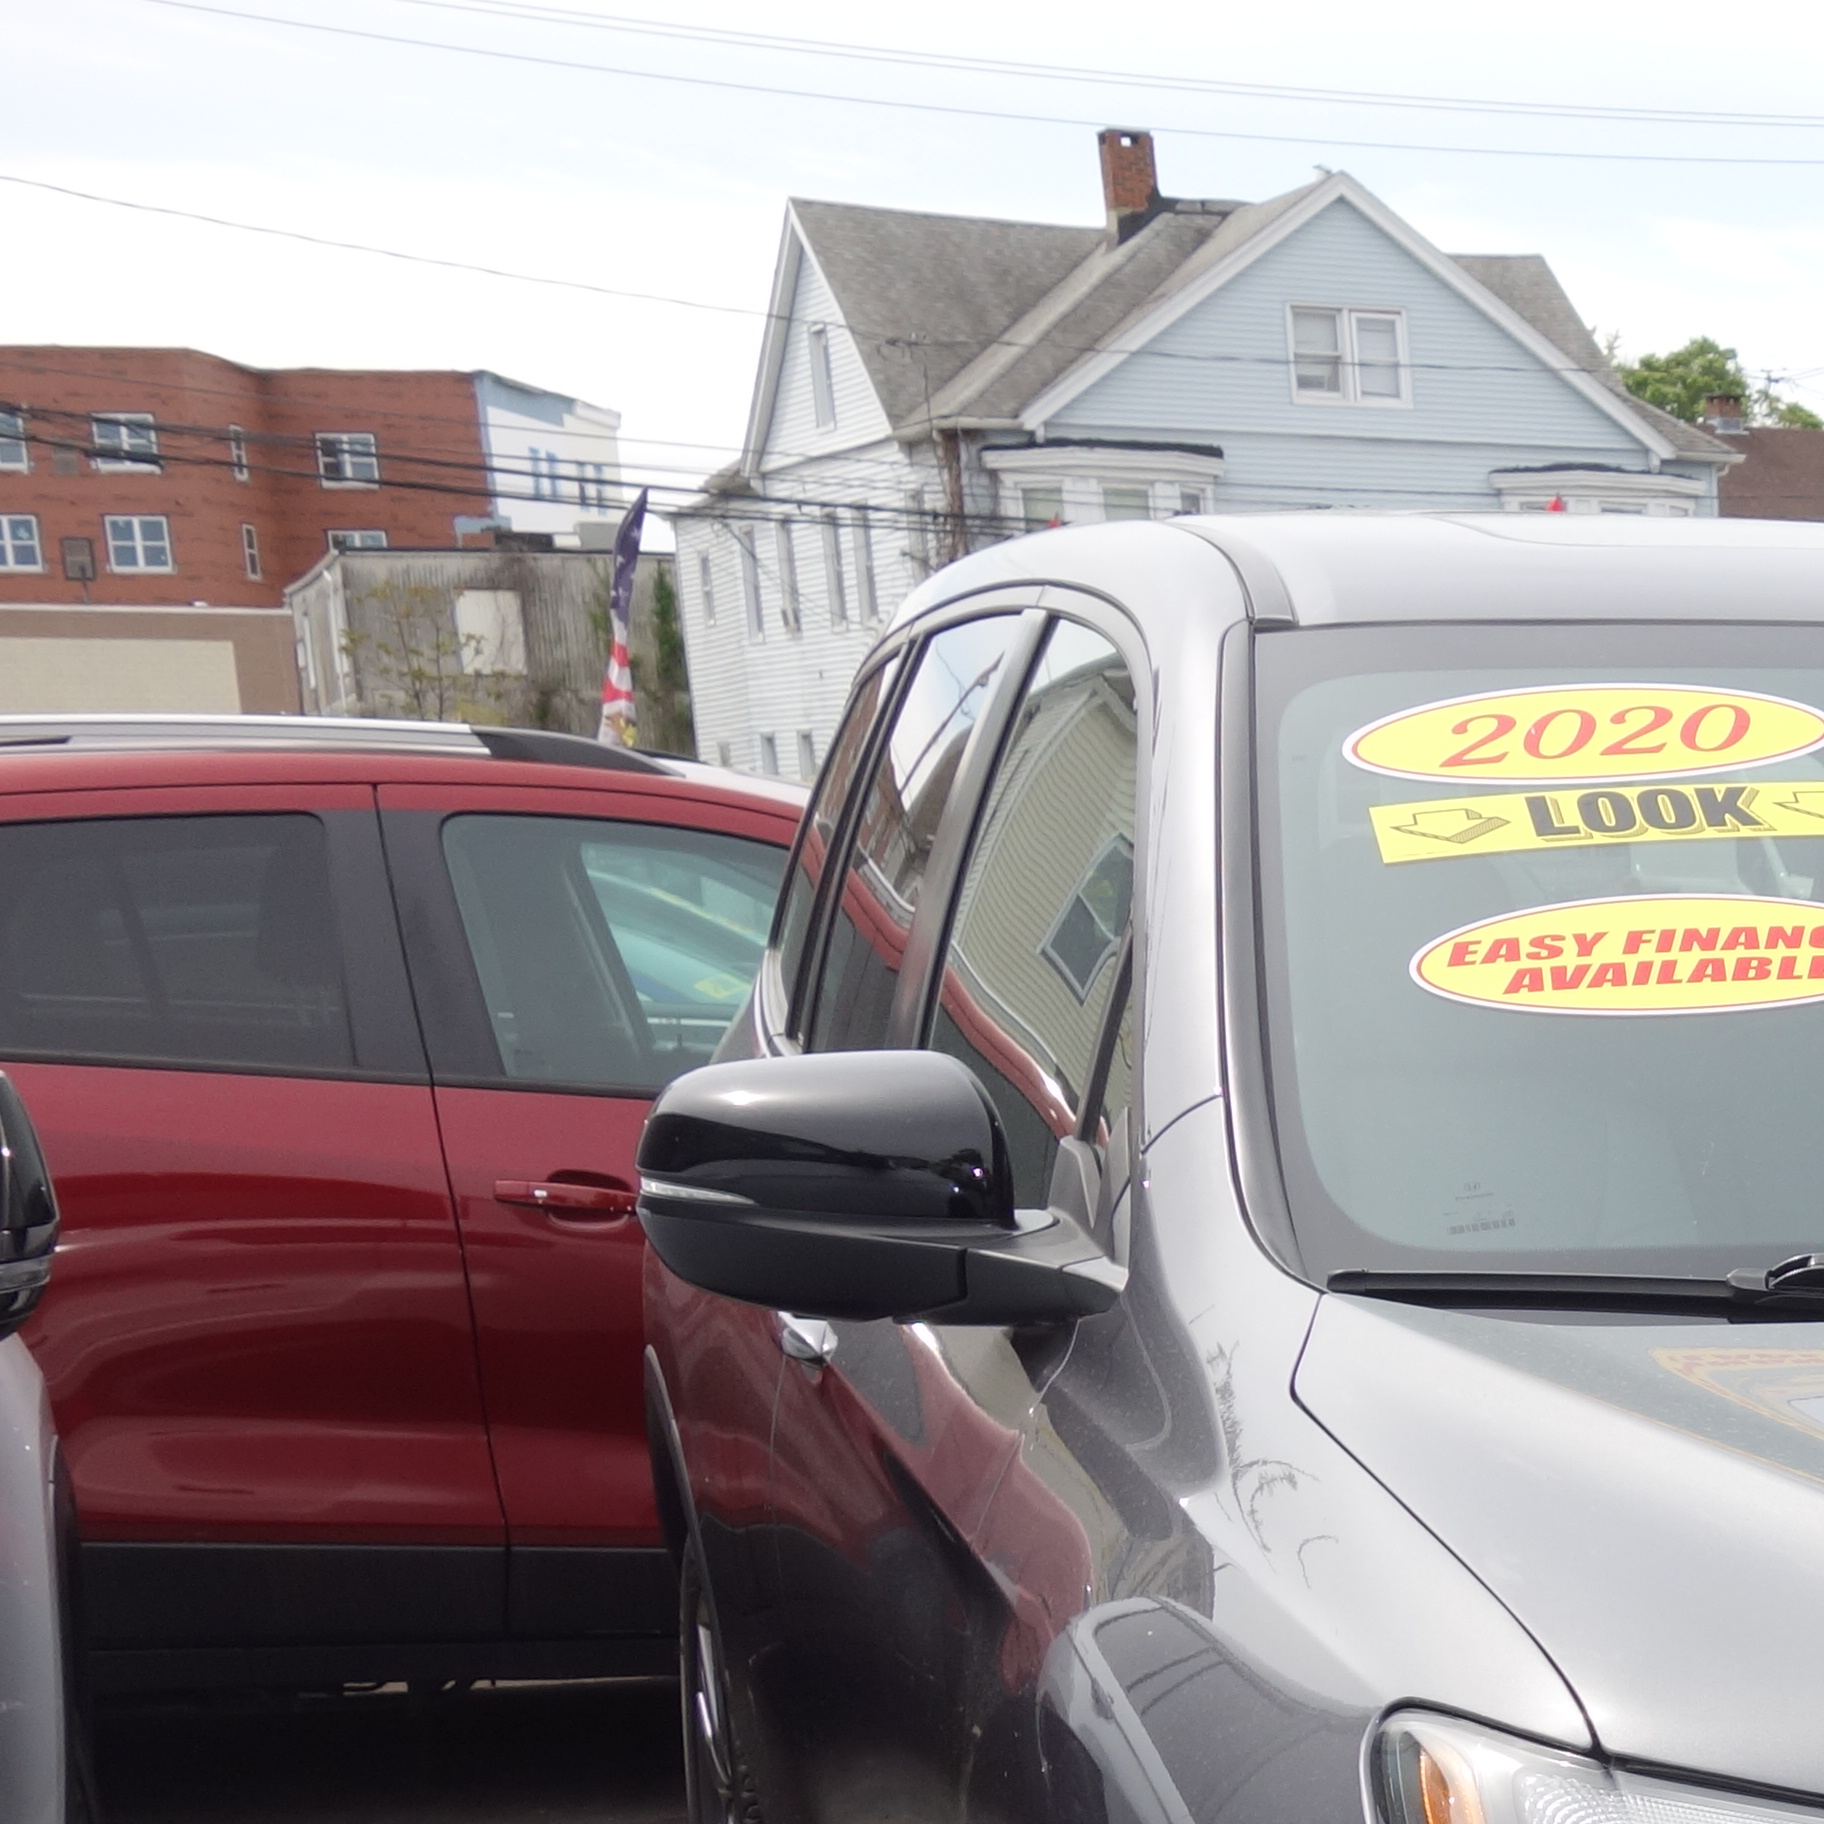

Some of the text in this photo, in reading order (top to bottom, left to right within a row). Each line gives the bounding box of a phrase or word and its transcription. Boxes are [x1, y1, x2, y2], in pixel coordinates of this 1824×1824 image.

[1439, 703, 1751, 768] 2020
[1525, 786, 1772, 841] LOOK
[1446, 930, 1610, 968] EASY
